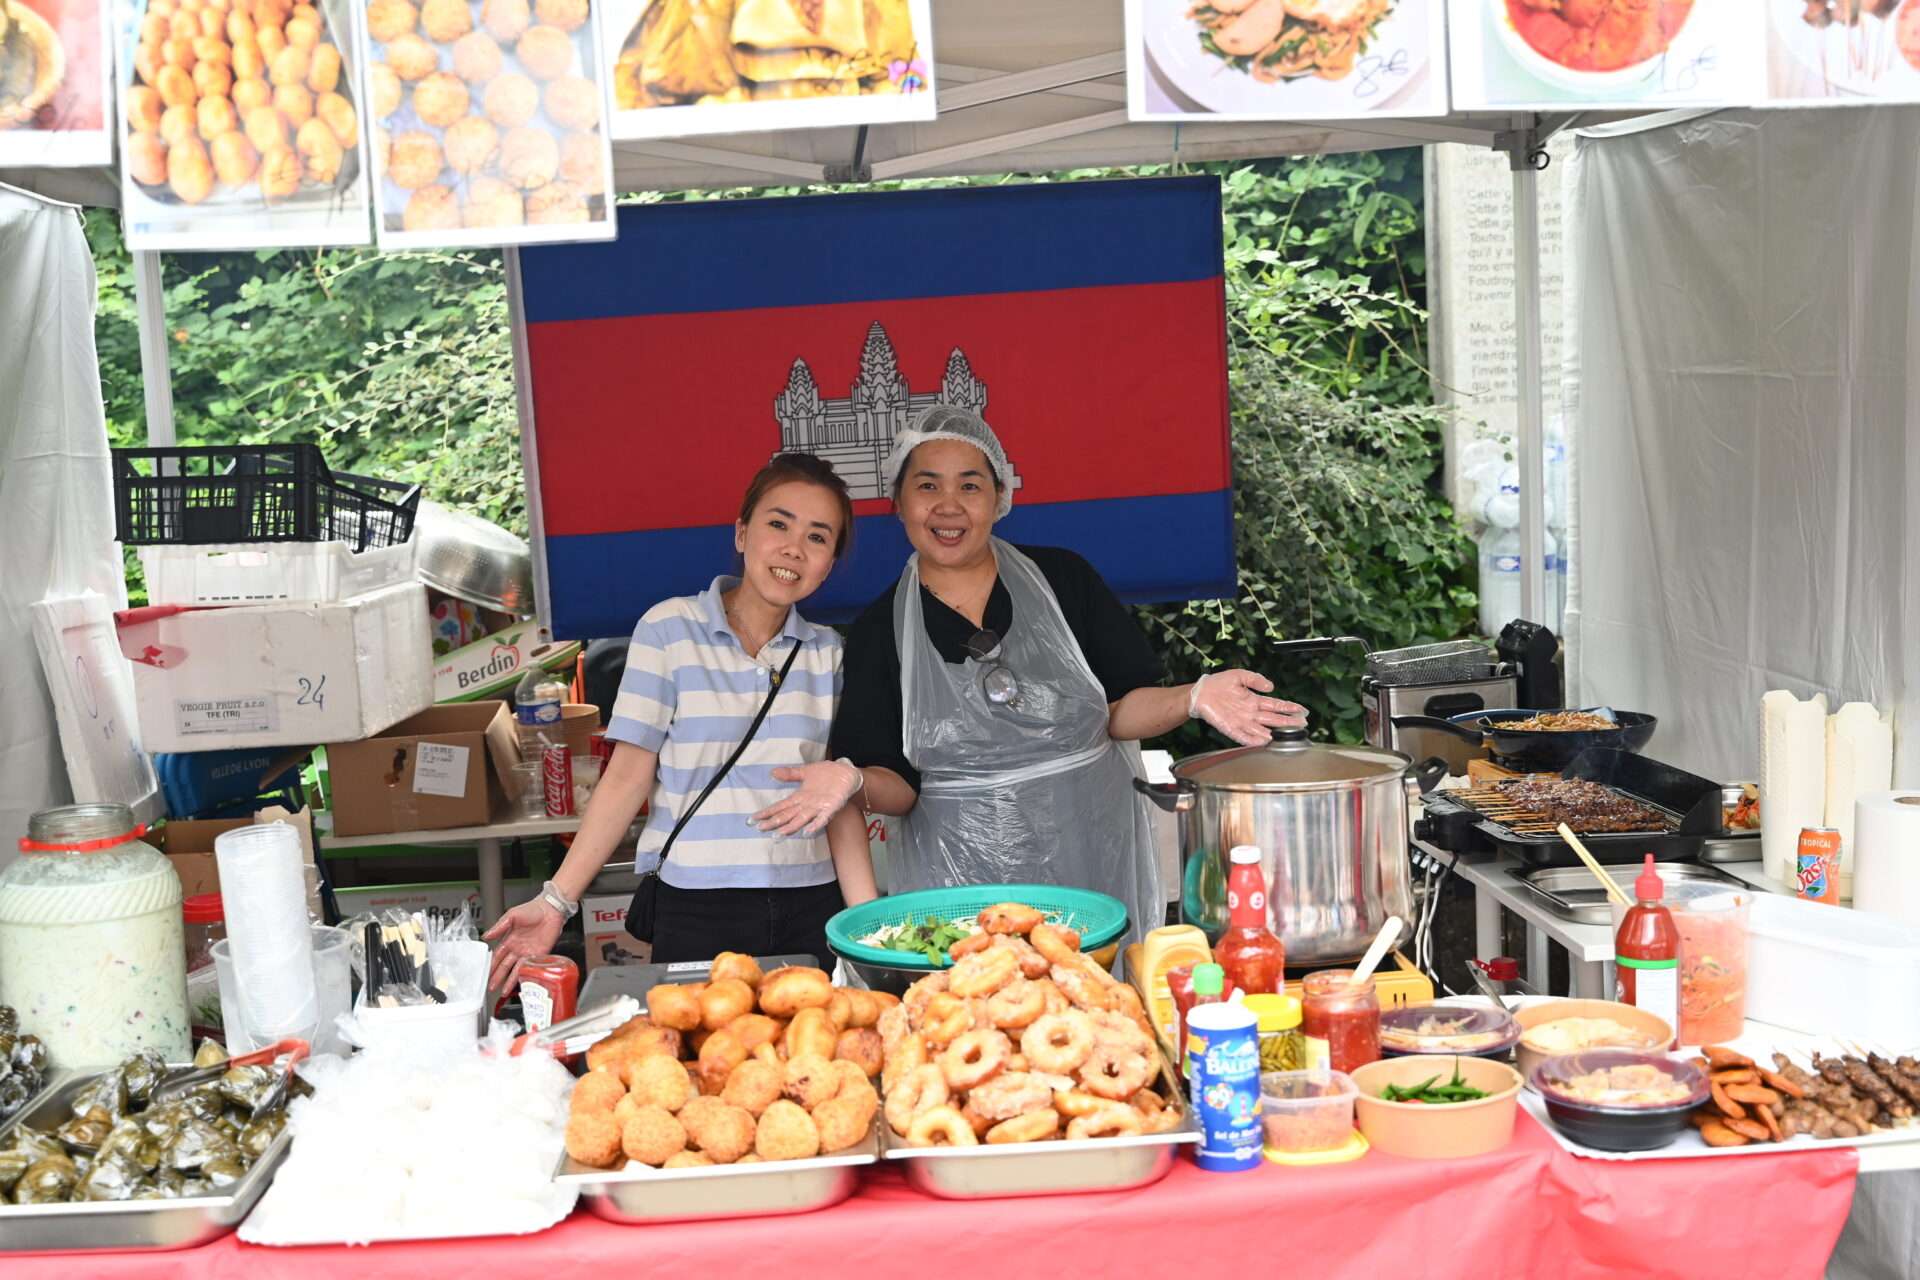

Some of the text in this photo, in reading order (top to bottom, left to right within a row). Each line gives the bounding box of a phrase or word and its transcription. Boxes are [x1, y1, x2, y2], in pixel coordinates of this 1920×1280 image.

[1469, 275, 1515, 289] Foudroy
[457, 654, 514, 688] Berdin
[297, 674, 326, 712] 24
[180, 702, 213, 712] VEGGIE
[216, 700, 242, 710] FRUIT
[243, 757, 271, 770] LYON
[592, 908, 629, 923] Tef
